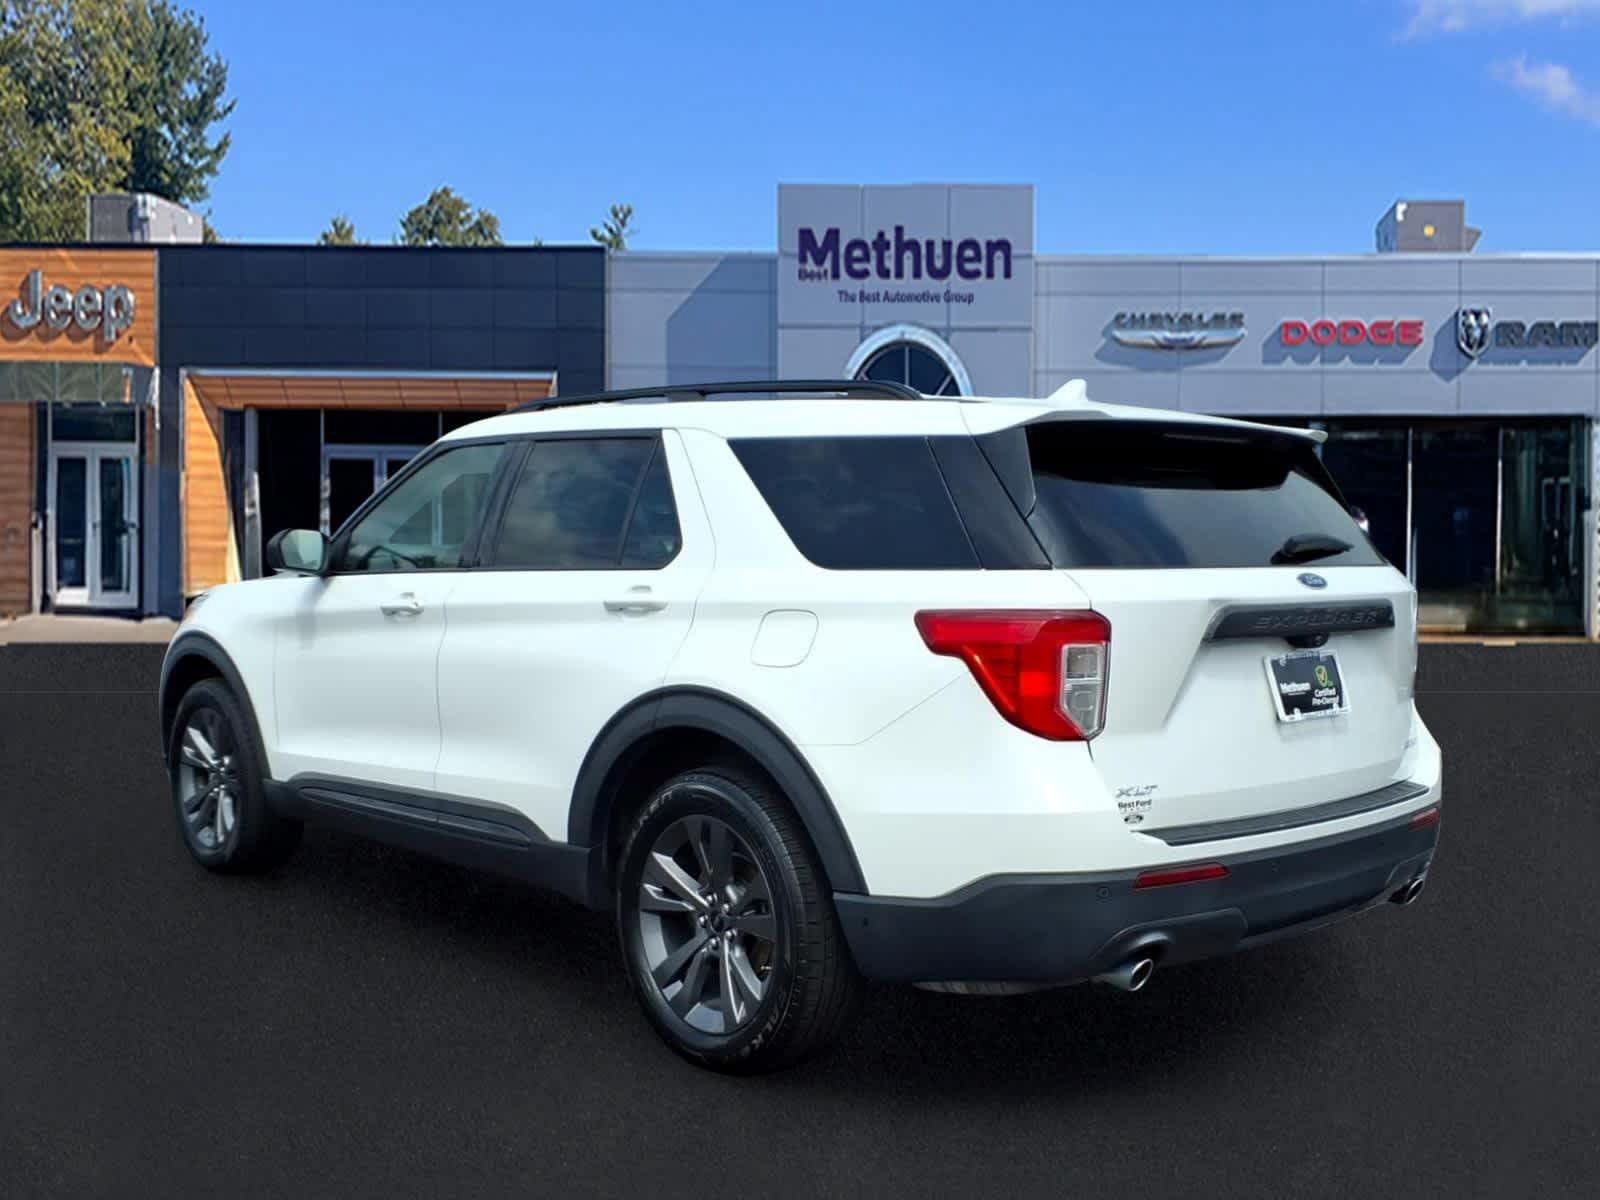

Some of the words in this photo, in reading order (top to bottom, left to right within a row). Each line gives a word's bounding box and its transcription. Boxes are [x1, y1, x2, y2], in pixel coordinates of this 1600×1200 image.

[798, 225, 1012, 280] Methuen
[798, 268, 829, 281] Best
[8, 268, 134, 341] Jeep
[838, 290, 856, 303] The
[859, 290, 880, 303] Best
[883, 290, 940, 303] Automotive
[943, 290, 974, 305] Group
[1112, 312, 1245, 328] CHRYSLER
[1281, 320, 1425, 345] DODGE
[1495, 321, 1599, 346] RAM
[1255, 608, 1377, 630] EXPLORER
[1280, 682, 1309, 693] Methuen
[1115, 784, 1158, 798] XLT
